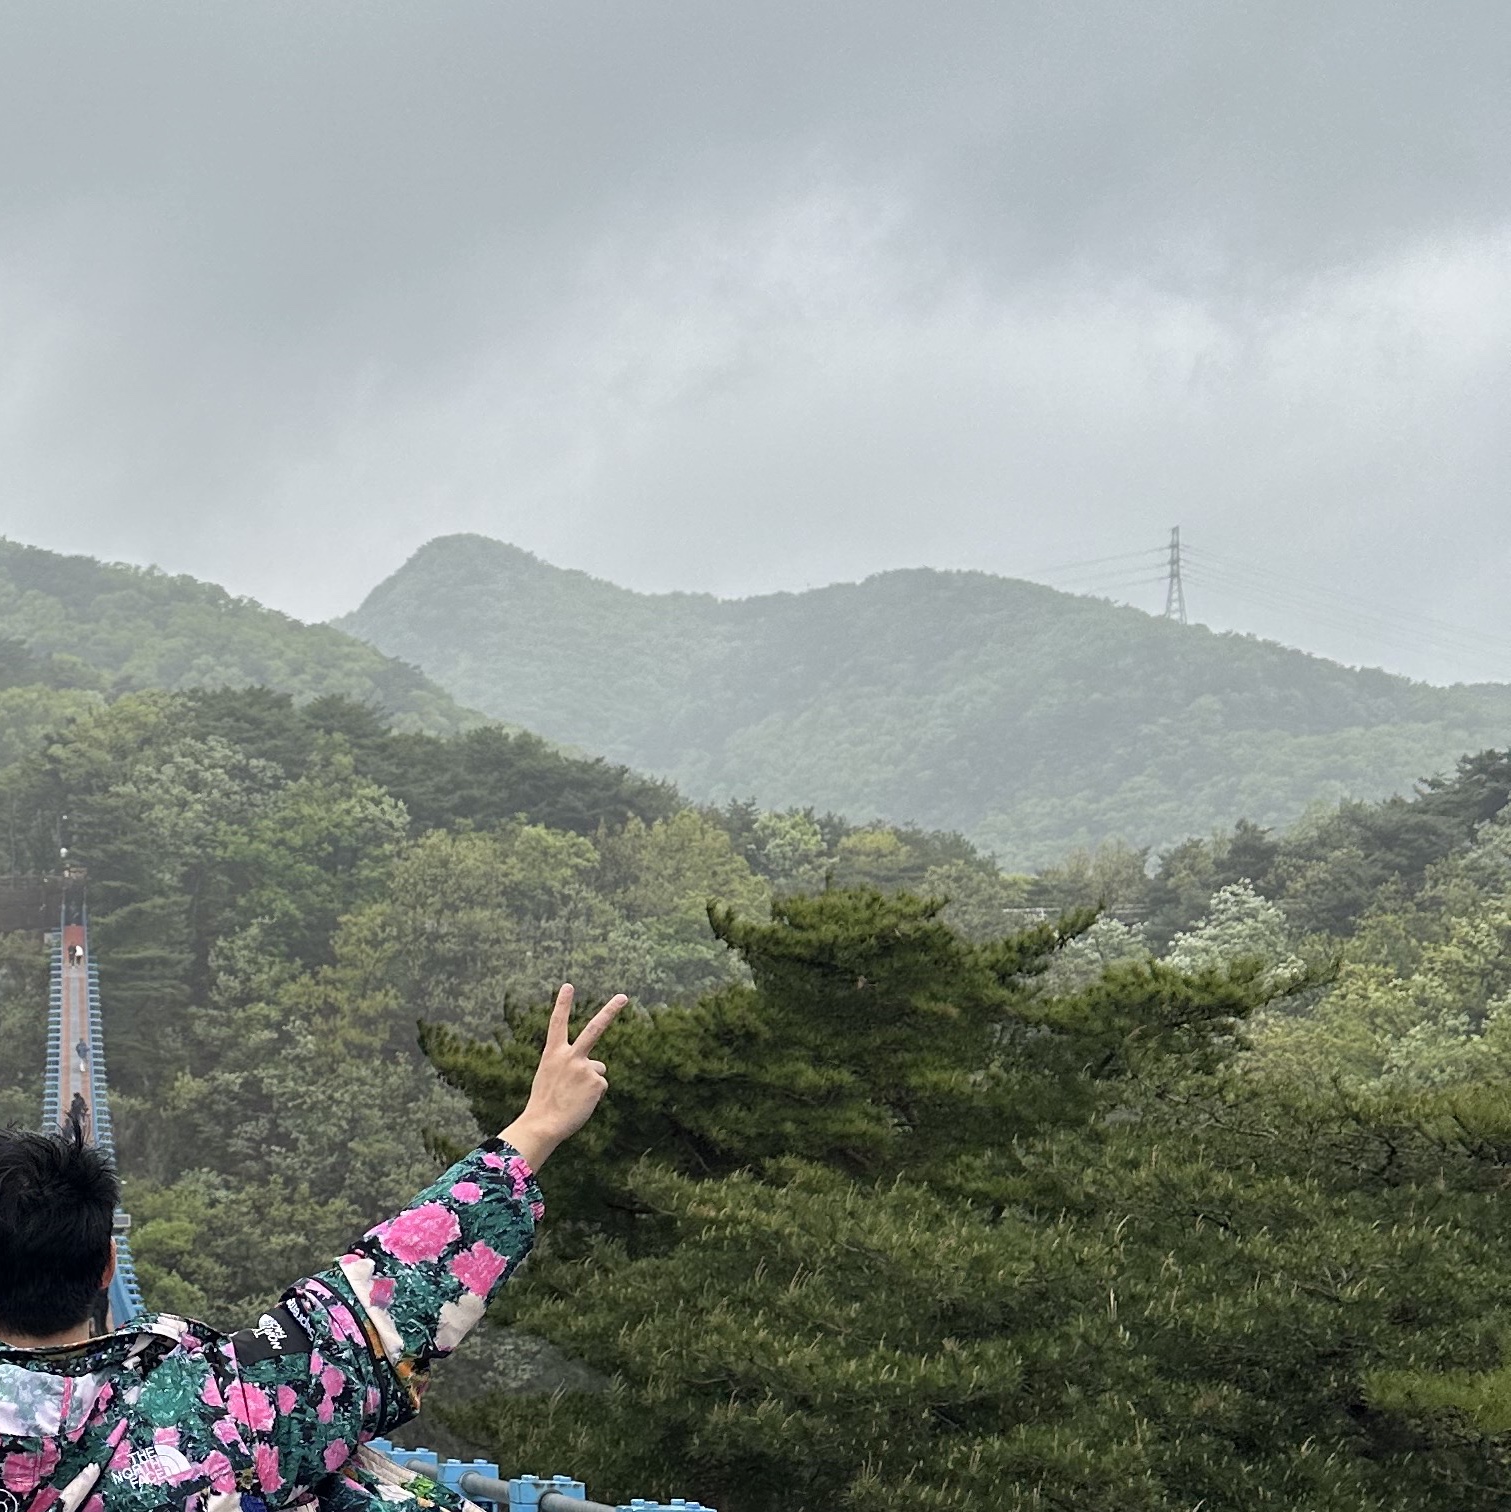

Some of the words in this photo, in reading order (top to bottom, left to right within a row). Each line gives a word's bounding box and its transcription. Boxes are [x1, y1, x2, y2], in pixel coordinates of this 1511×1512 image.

[126, 1446, 159, 1465] THE
[110, 1456, 161, 1486] NORTH
[129, 1467, 168, 1493] FACE
